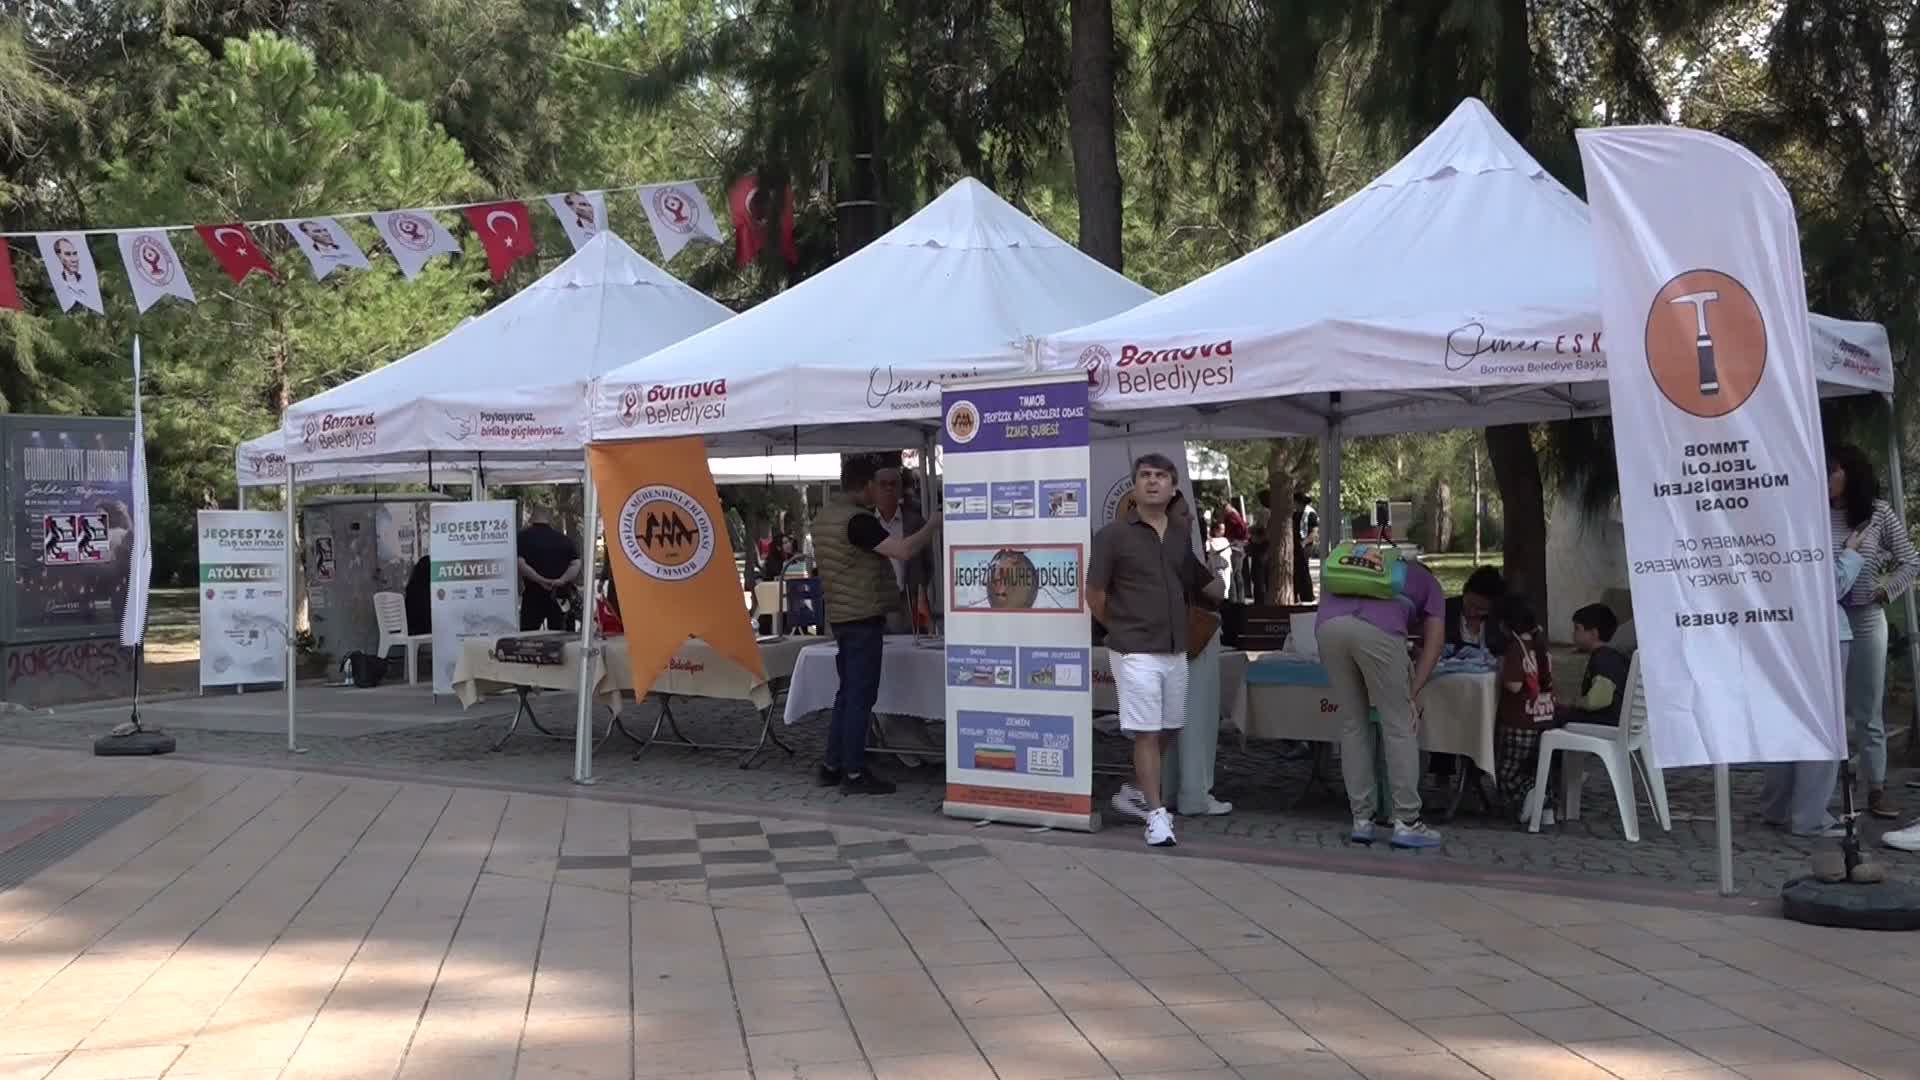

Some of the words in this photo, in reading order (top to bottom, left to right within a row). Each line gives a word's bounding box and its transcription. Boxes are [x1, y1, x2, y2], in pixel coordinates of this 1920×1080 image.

[1117, 340, 1233, 367] Bornova
[1556, 332, 1602, 357] EŞK
[1117, 360, 1234, 394] Belediyesi
[1480, 363, 1525, 374] Bornova
[1527, 359, 1574, 373] Belediye
[1575, 357, 1608, 371] Başka
[648, 378, 727, 402] Bornova
[1018, 395, 1046, 406] TMMOB
[645, 398, 727, 425] Belediyesi
[318, 427, 377, 450] Belediyesi
[481, 425, 510, 437] birlikte
[655, 561, 697, 577] TMMOB
